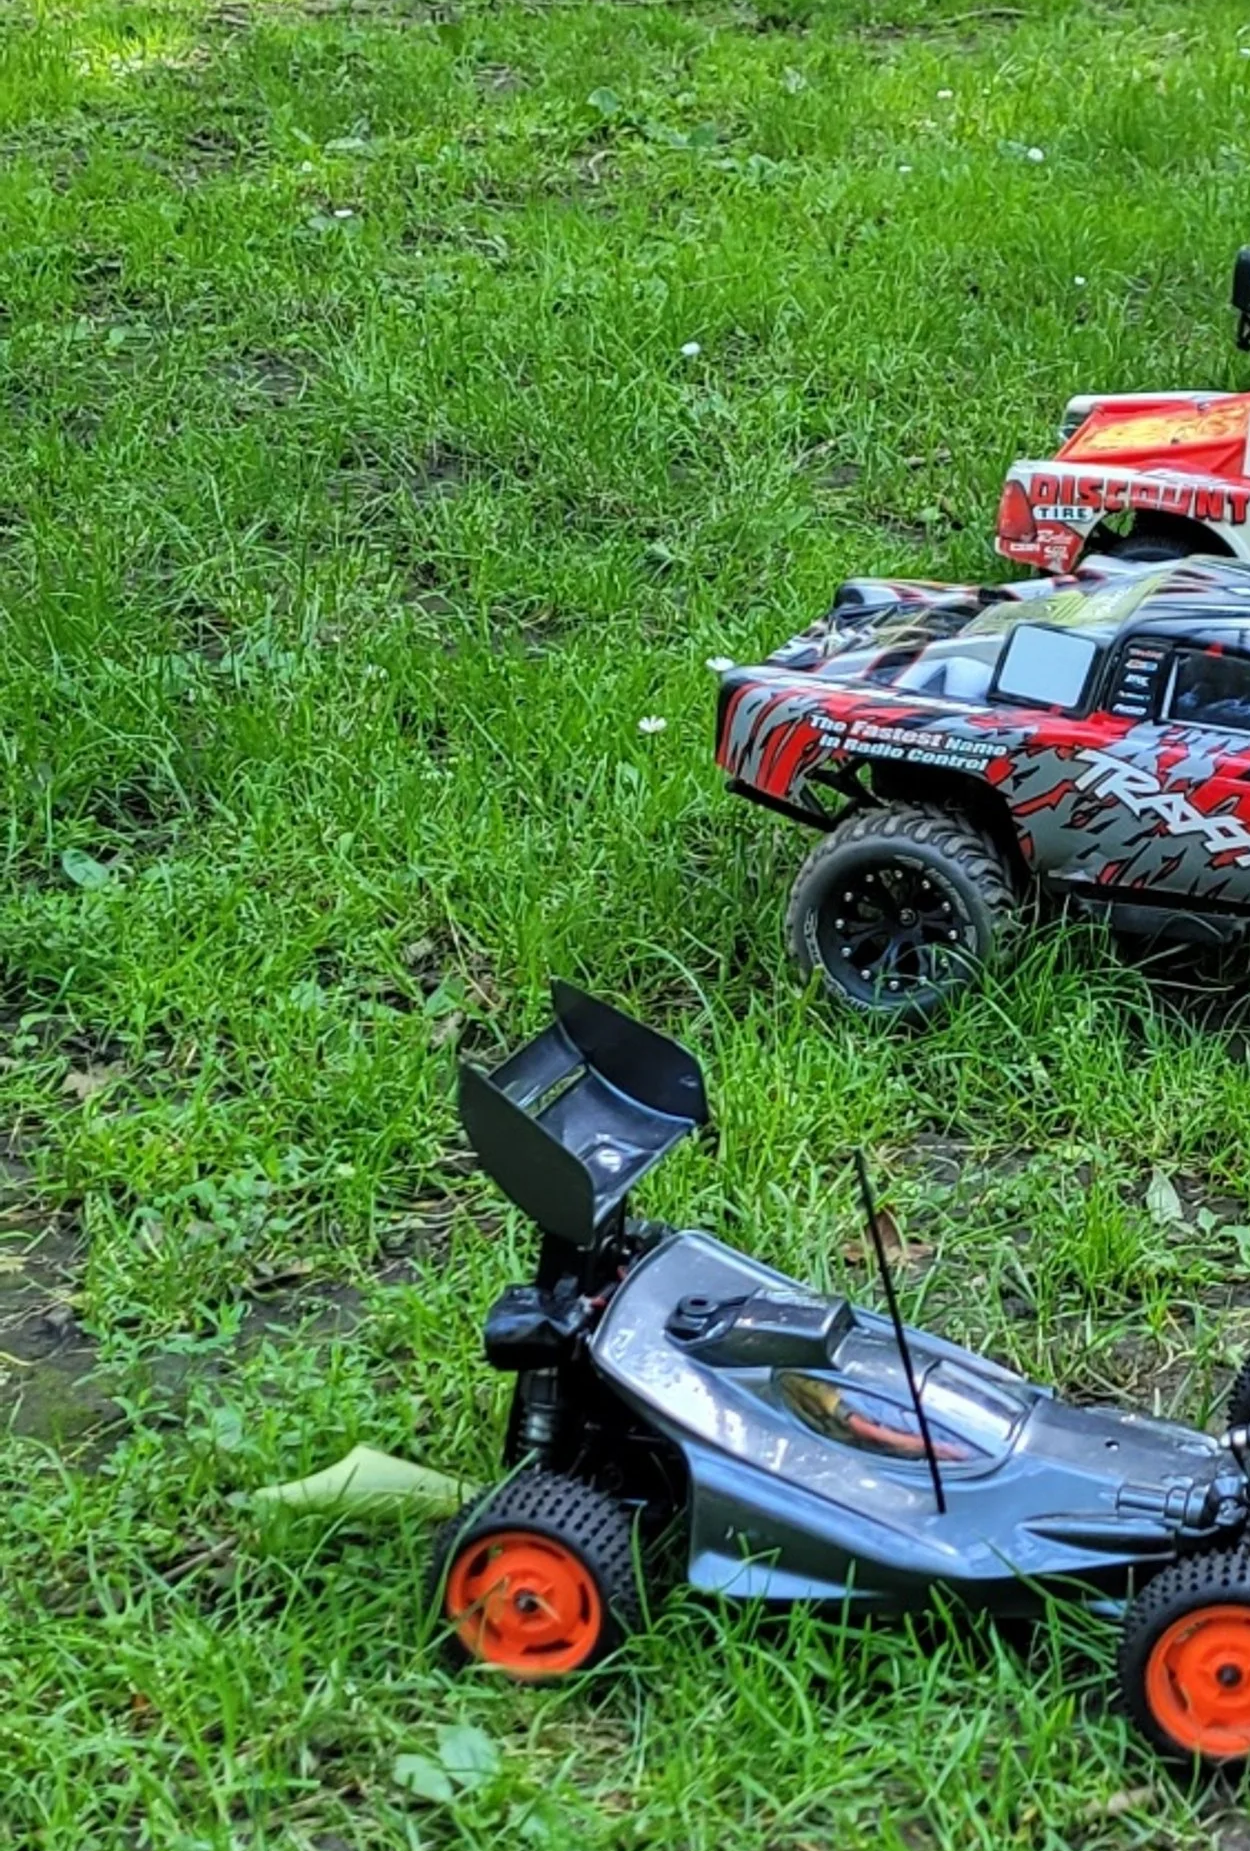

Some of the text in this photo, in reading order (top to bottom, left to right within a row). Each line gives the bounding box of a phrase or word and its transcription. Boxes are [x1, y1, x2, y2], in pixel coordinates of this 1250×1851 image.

[1036, 506, 1091, 520] TIRE
[810, 713, 1008, 757] The Fastest Name
[843, 737, 905, 759] Radio
[907, 747, 990, 771] Control
